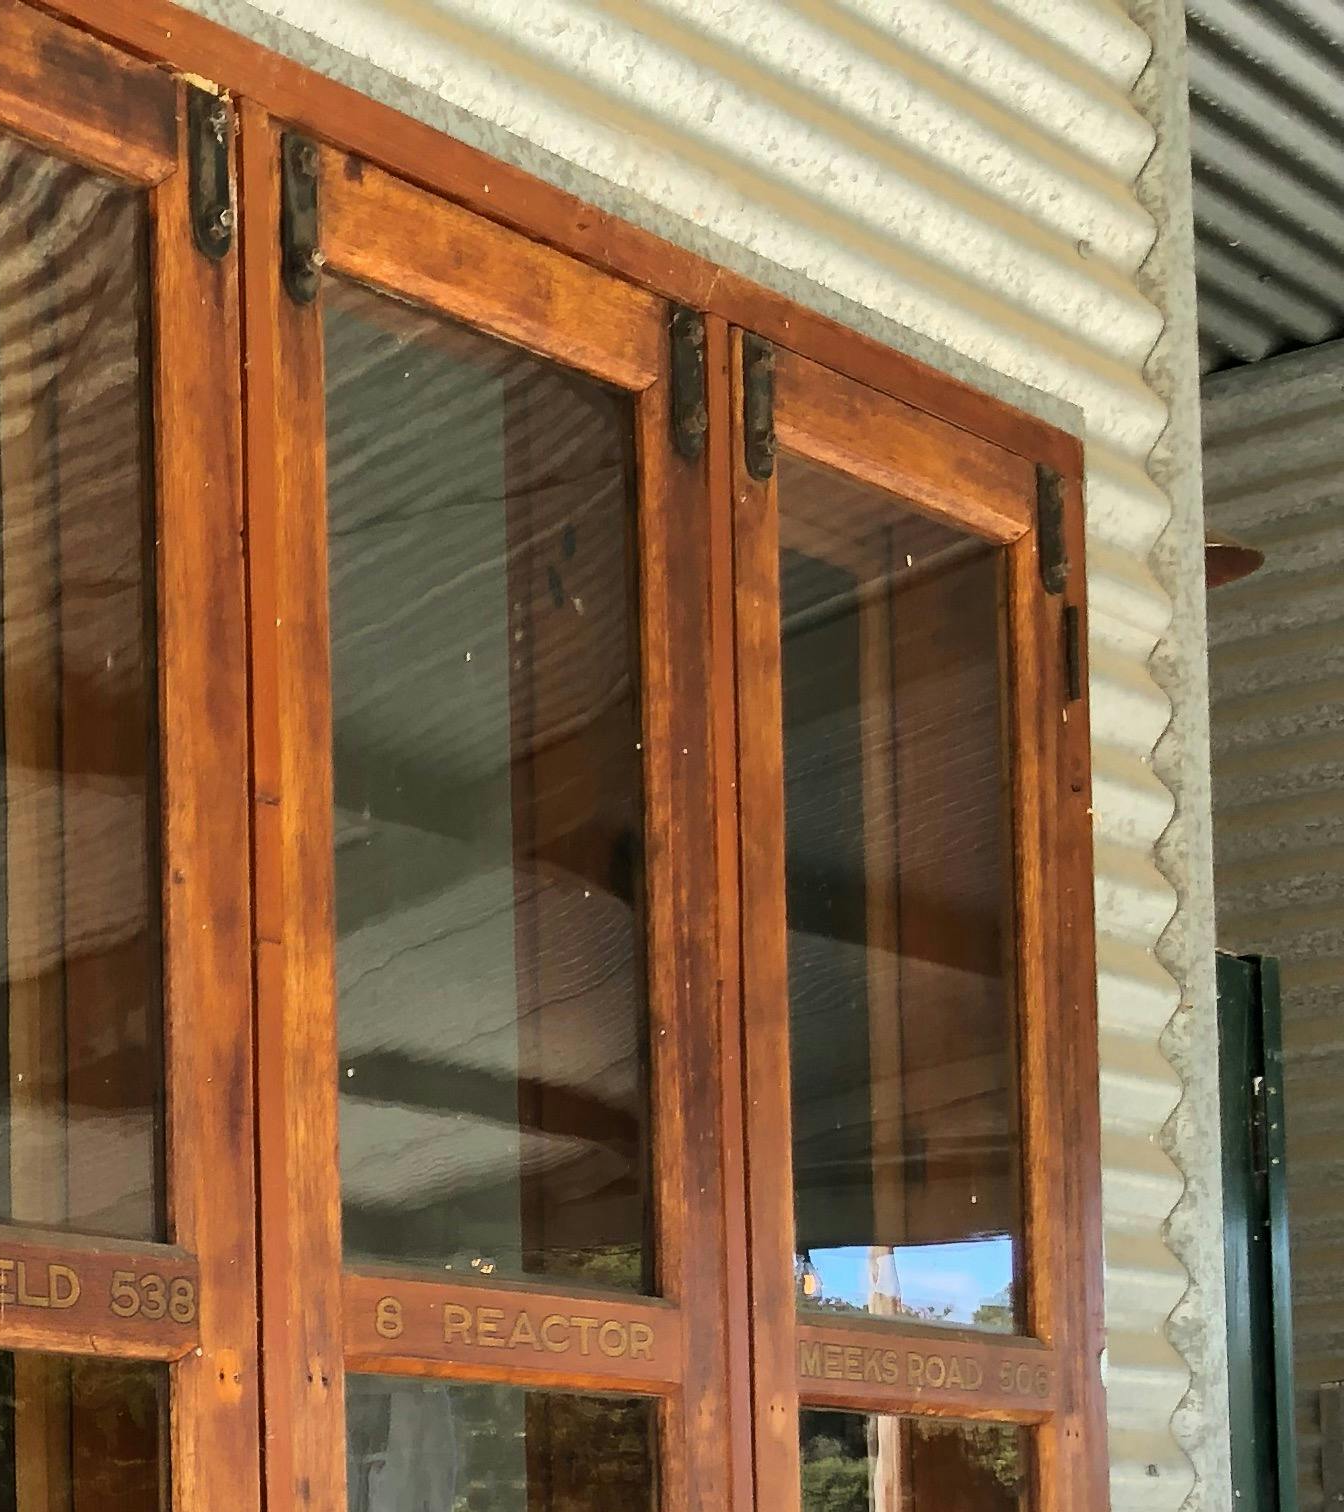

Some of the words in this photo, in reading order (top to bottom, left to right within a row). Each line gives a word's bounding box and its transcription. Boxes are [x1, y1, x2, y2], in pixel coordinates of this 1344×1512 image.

[110, 1270, 196, 1325] 538
[443, 1302, 655, 1361] REACTOR
[798, 1340, 899, 1385] MEEKS
[906, 1351, 983, 1391] ROAD
